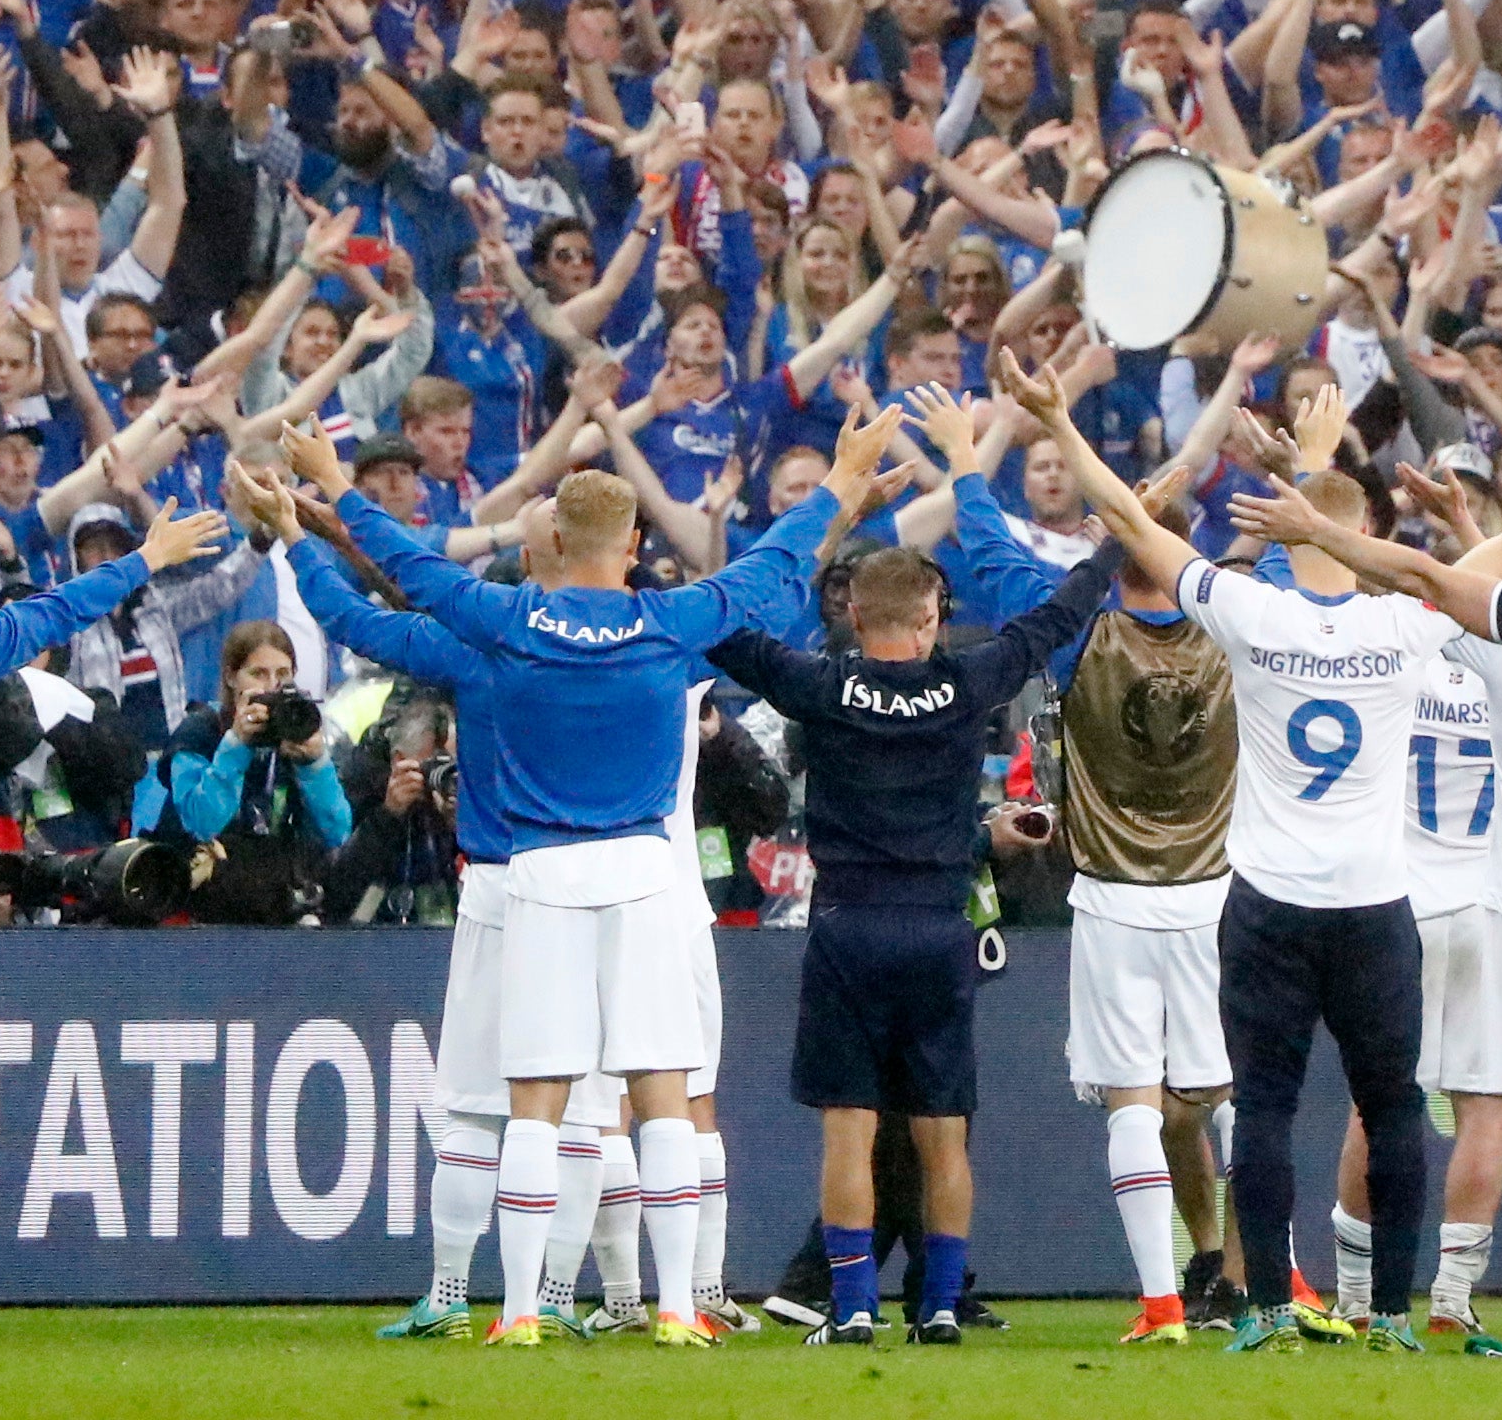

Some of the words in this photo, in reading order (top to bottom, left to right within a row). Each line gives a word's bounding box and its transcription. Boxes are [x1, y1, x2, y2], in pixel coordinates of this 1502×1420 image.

[526, 606, 644, 644] ÍSLAND
[1249, 646, 1403, 680] SIGTHÓRSSON
[841, 674, 955, 719] ÍSLAND
[1285, 697, 1364, 803] 9
[1408, 734, 1495, 837] 17
